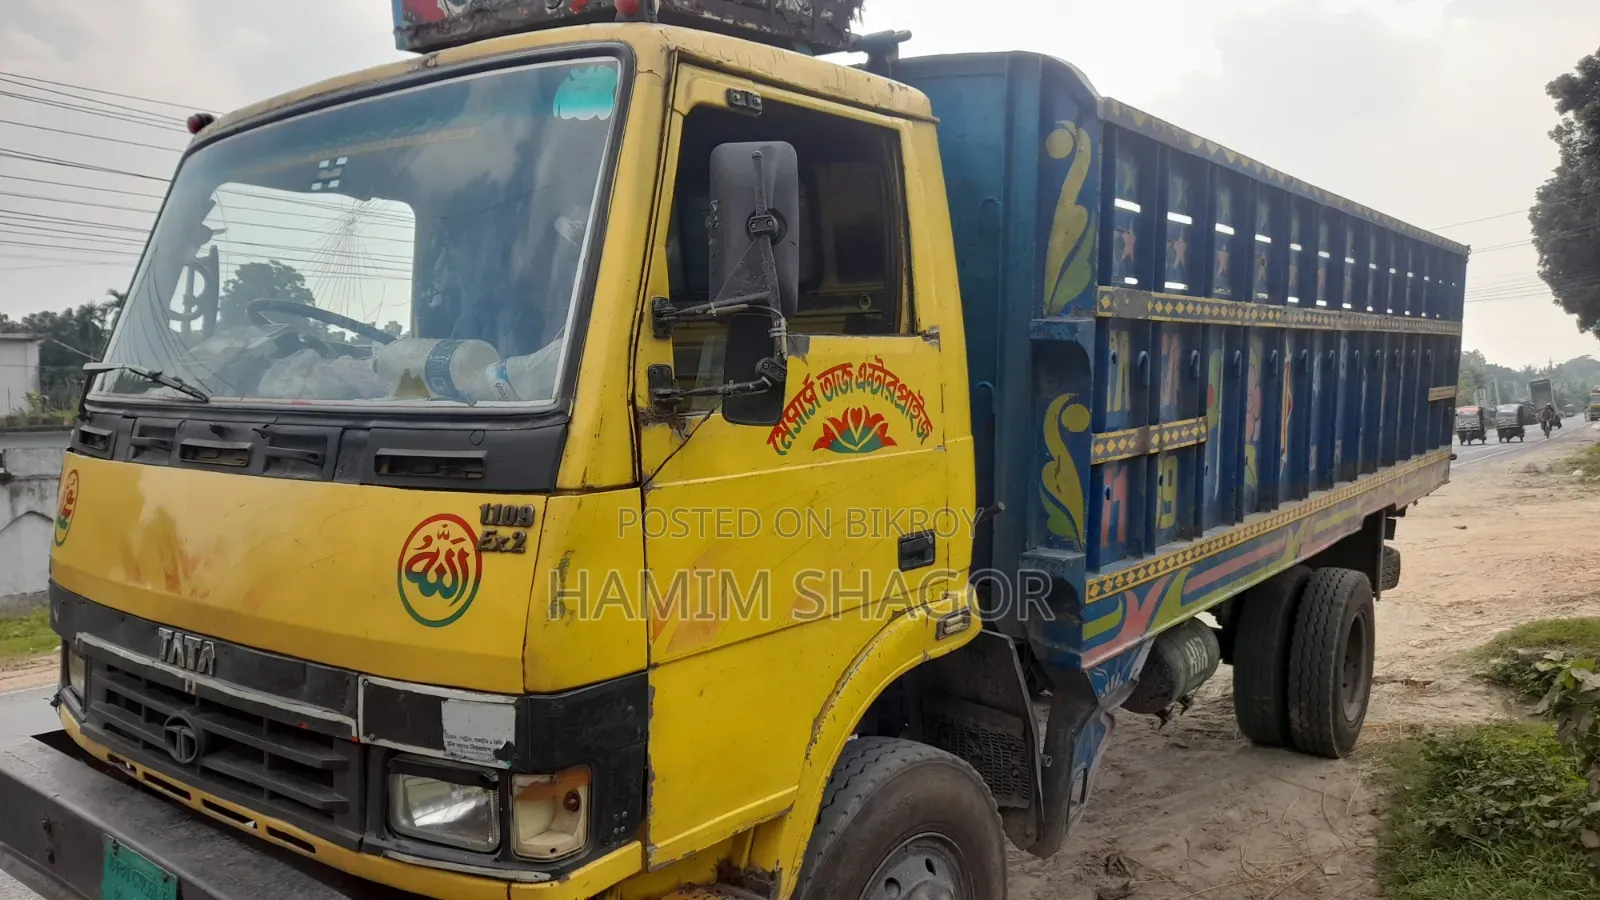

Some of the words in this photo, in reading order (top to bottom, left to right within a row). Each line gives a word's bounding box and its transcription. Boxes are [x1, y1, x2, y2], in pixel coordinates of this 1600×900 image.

[766, 373, 821, 455] মেসার্স
[816, 362, 854, 402] তাজ
[855, 355, 933, 446] এন্টারপ্রাইজ
[479, 503, 535, 527] 1109
[158, 626, 215, 677] TATA
